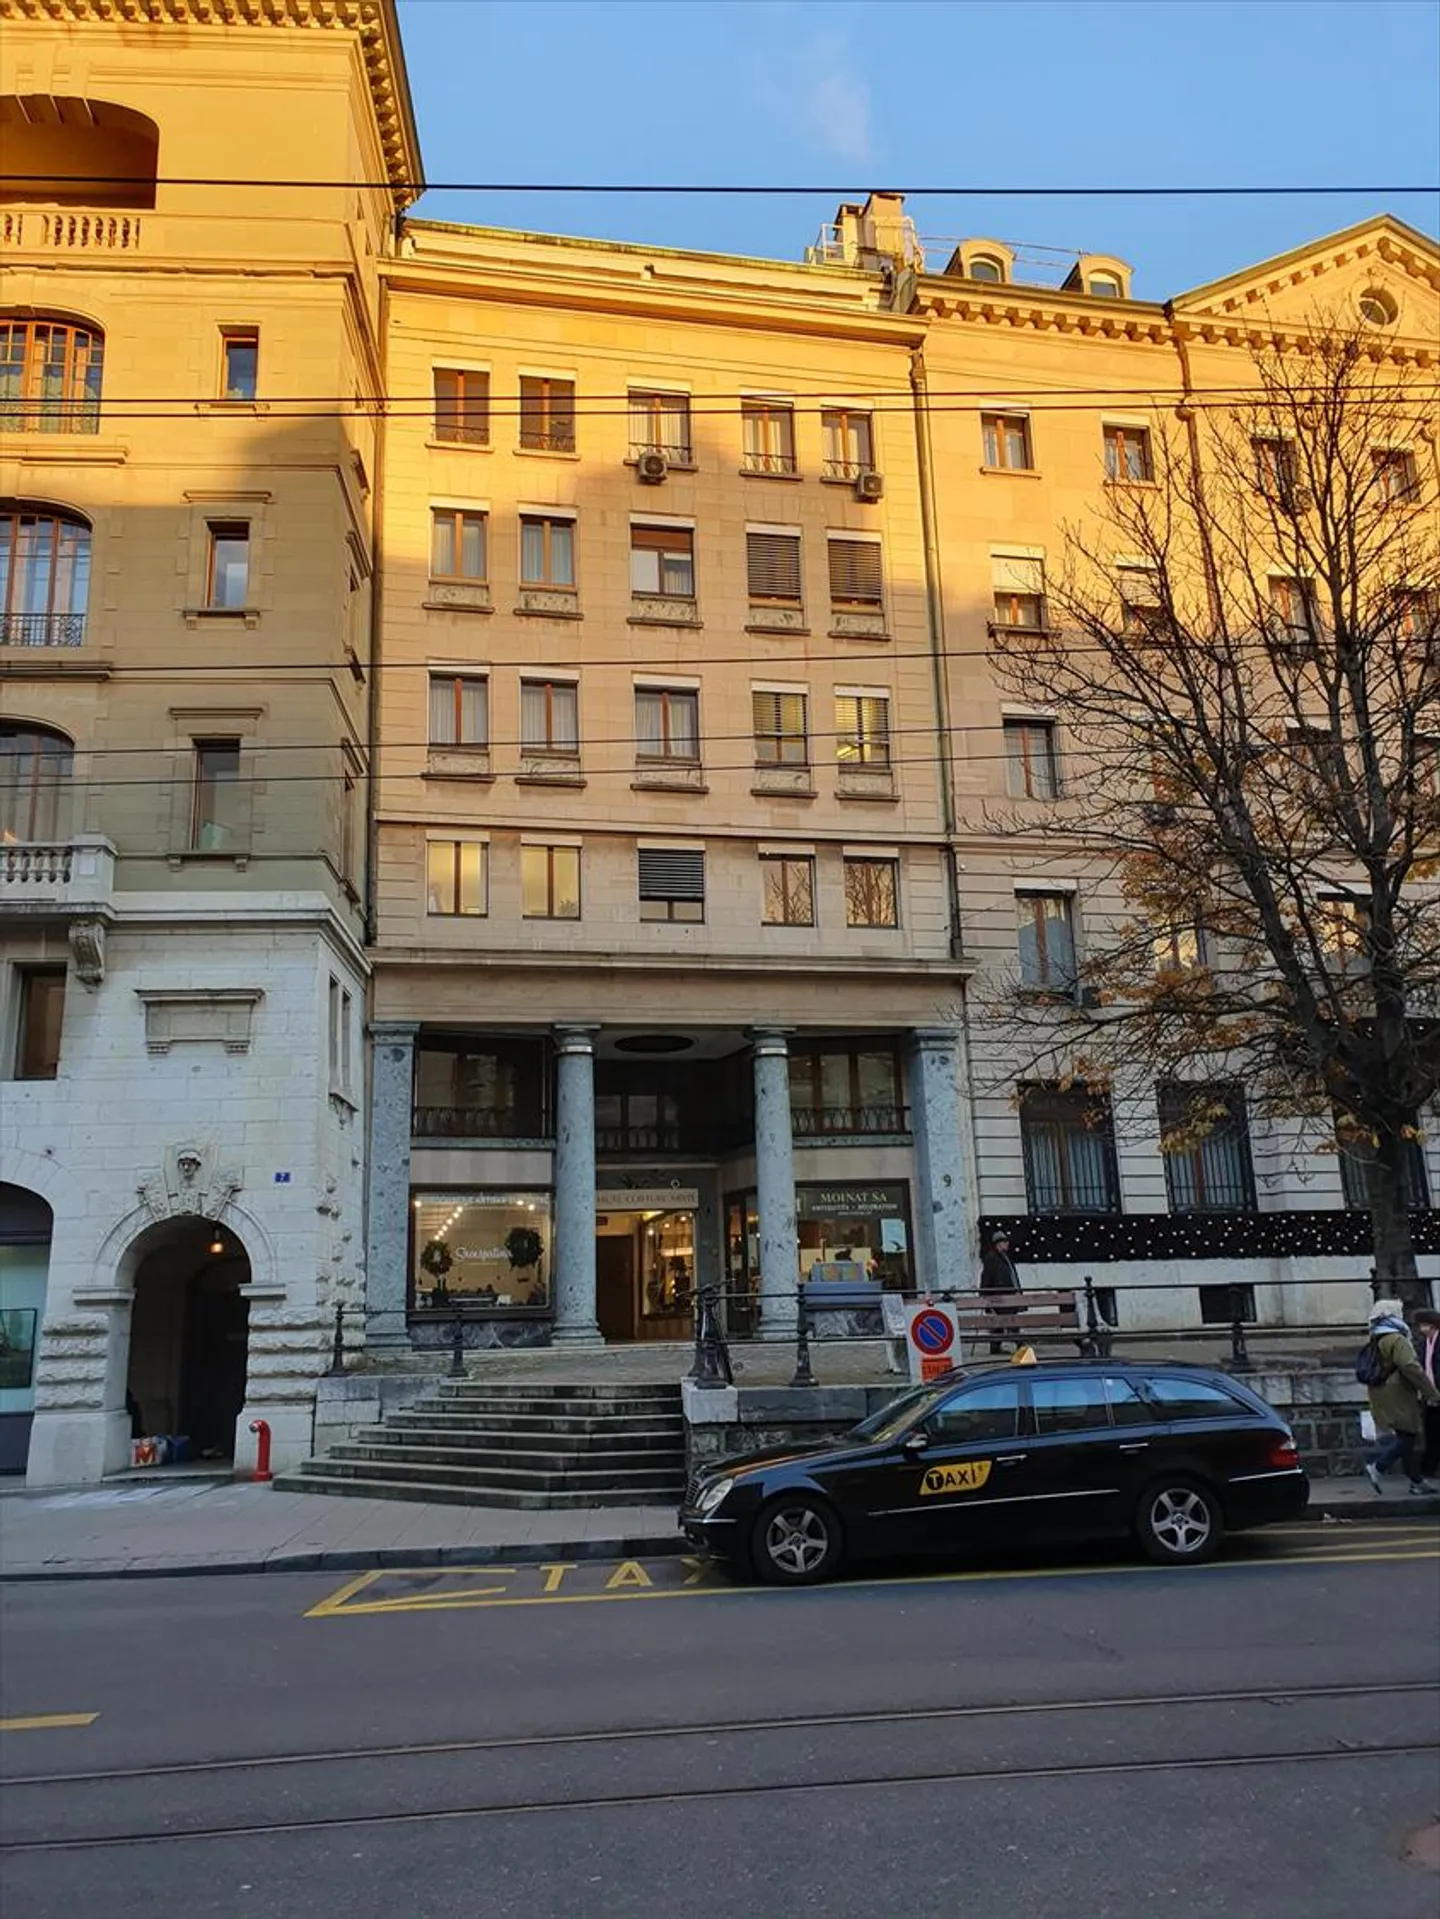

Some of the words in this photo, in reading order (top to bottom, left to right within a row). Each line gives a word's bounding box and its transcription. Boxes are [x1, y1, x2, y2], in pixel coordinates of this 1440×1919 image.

[820, 1190, 868, 1203] MOINAT
[871, 1189, 888, 1203] SA
[926, 1463, 977, 1490] TAXI
